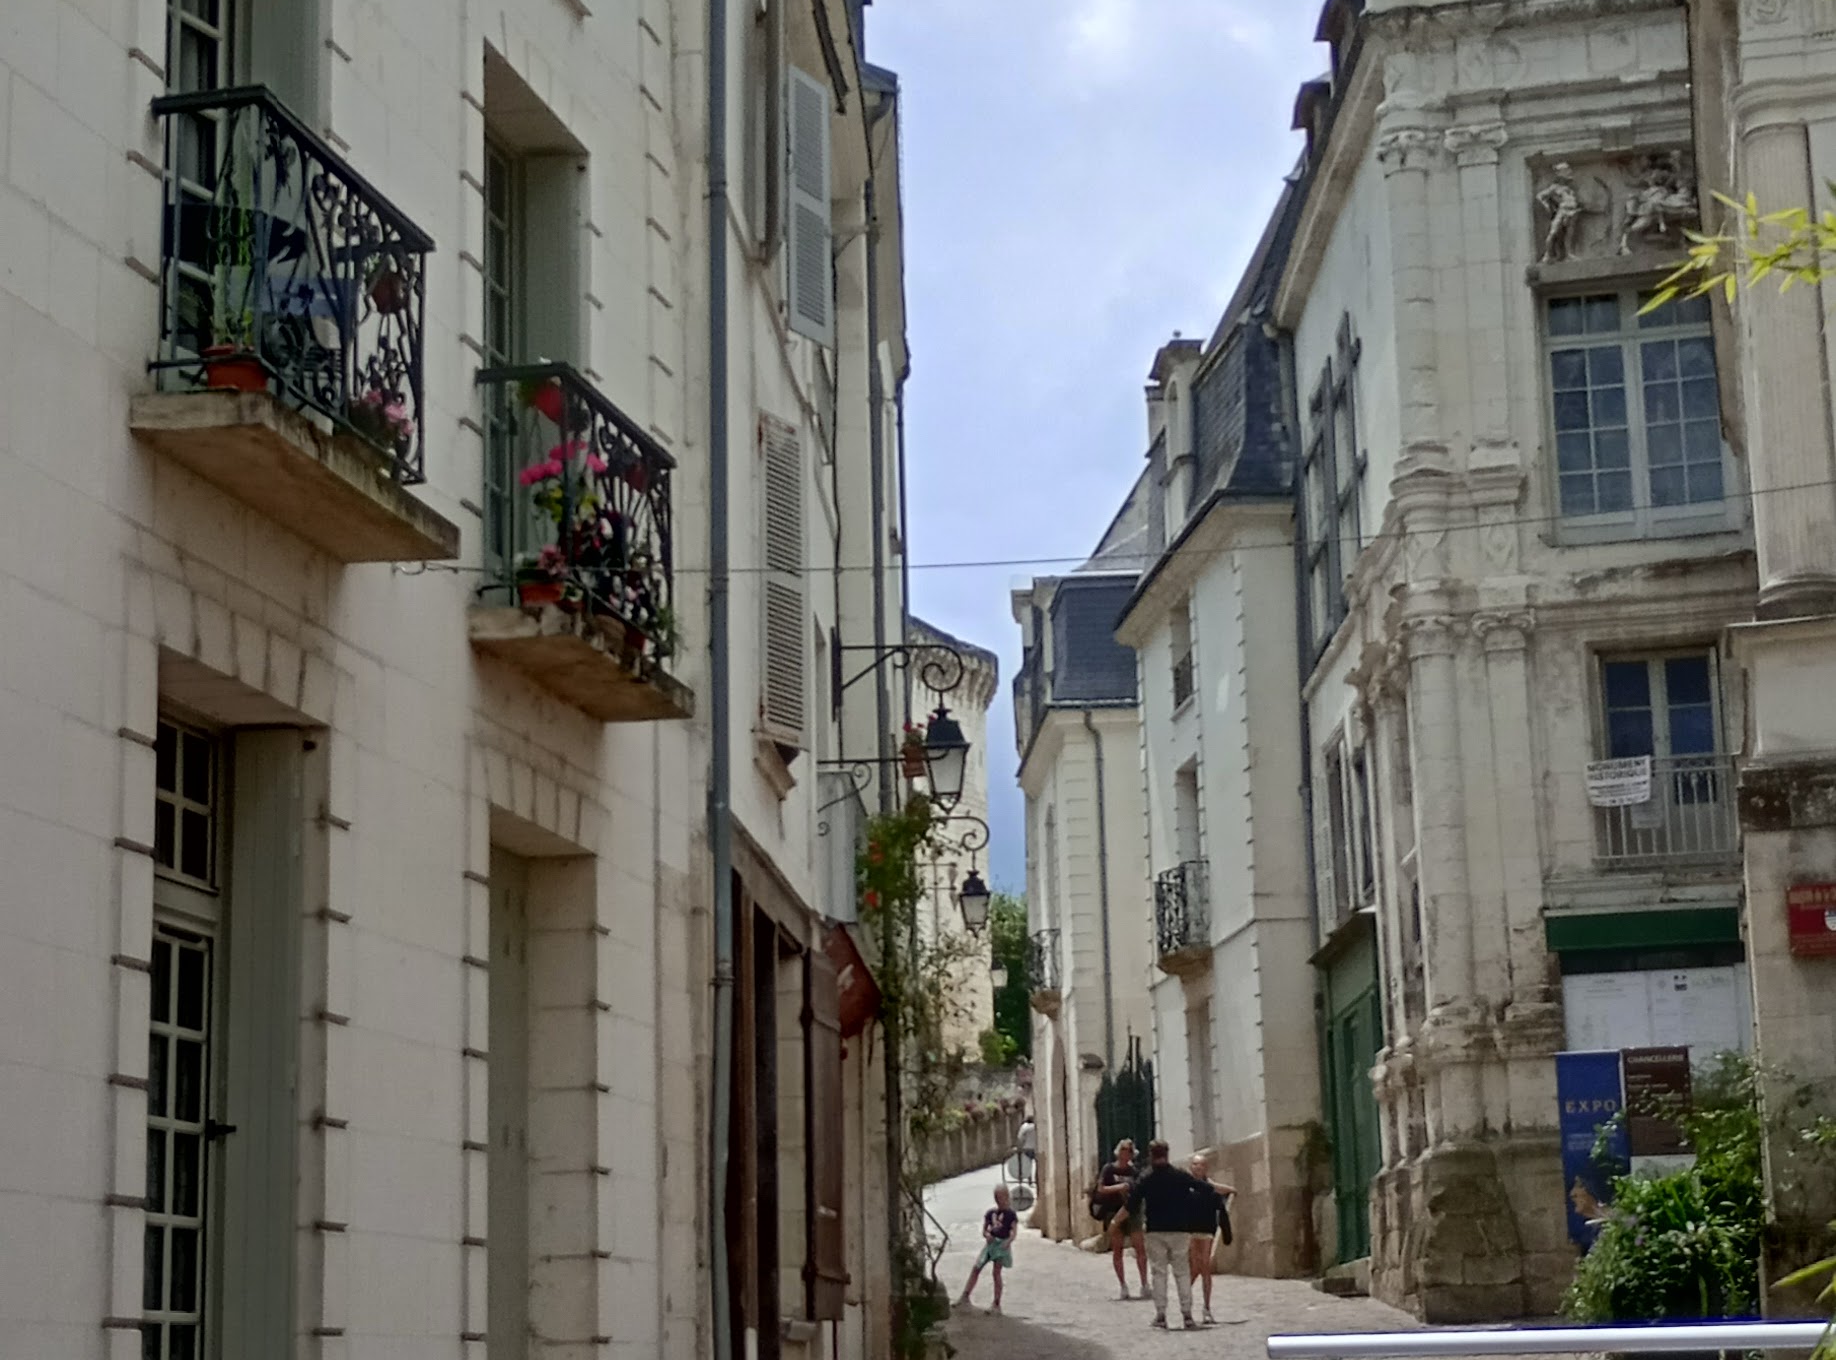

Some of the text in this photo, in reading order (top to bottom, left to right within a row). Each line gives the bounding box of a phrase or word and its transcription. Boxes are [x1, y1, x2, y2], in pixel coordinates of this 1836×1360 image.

[1587, 759, 1646, 771] MONUMENT
[1587, 767, 1647, 780] HISTORIQUE
[1626, 1054, 1685, 1063] CHANCELLERIE
[1565, 1099, 1617, 1113] EXPO
